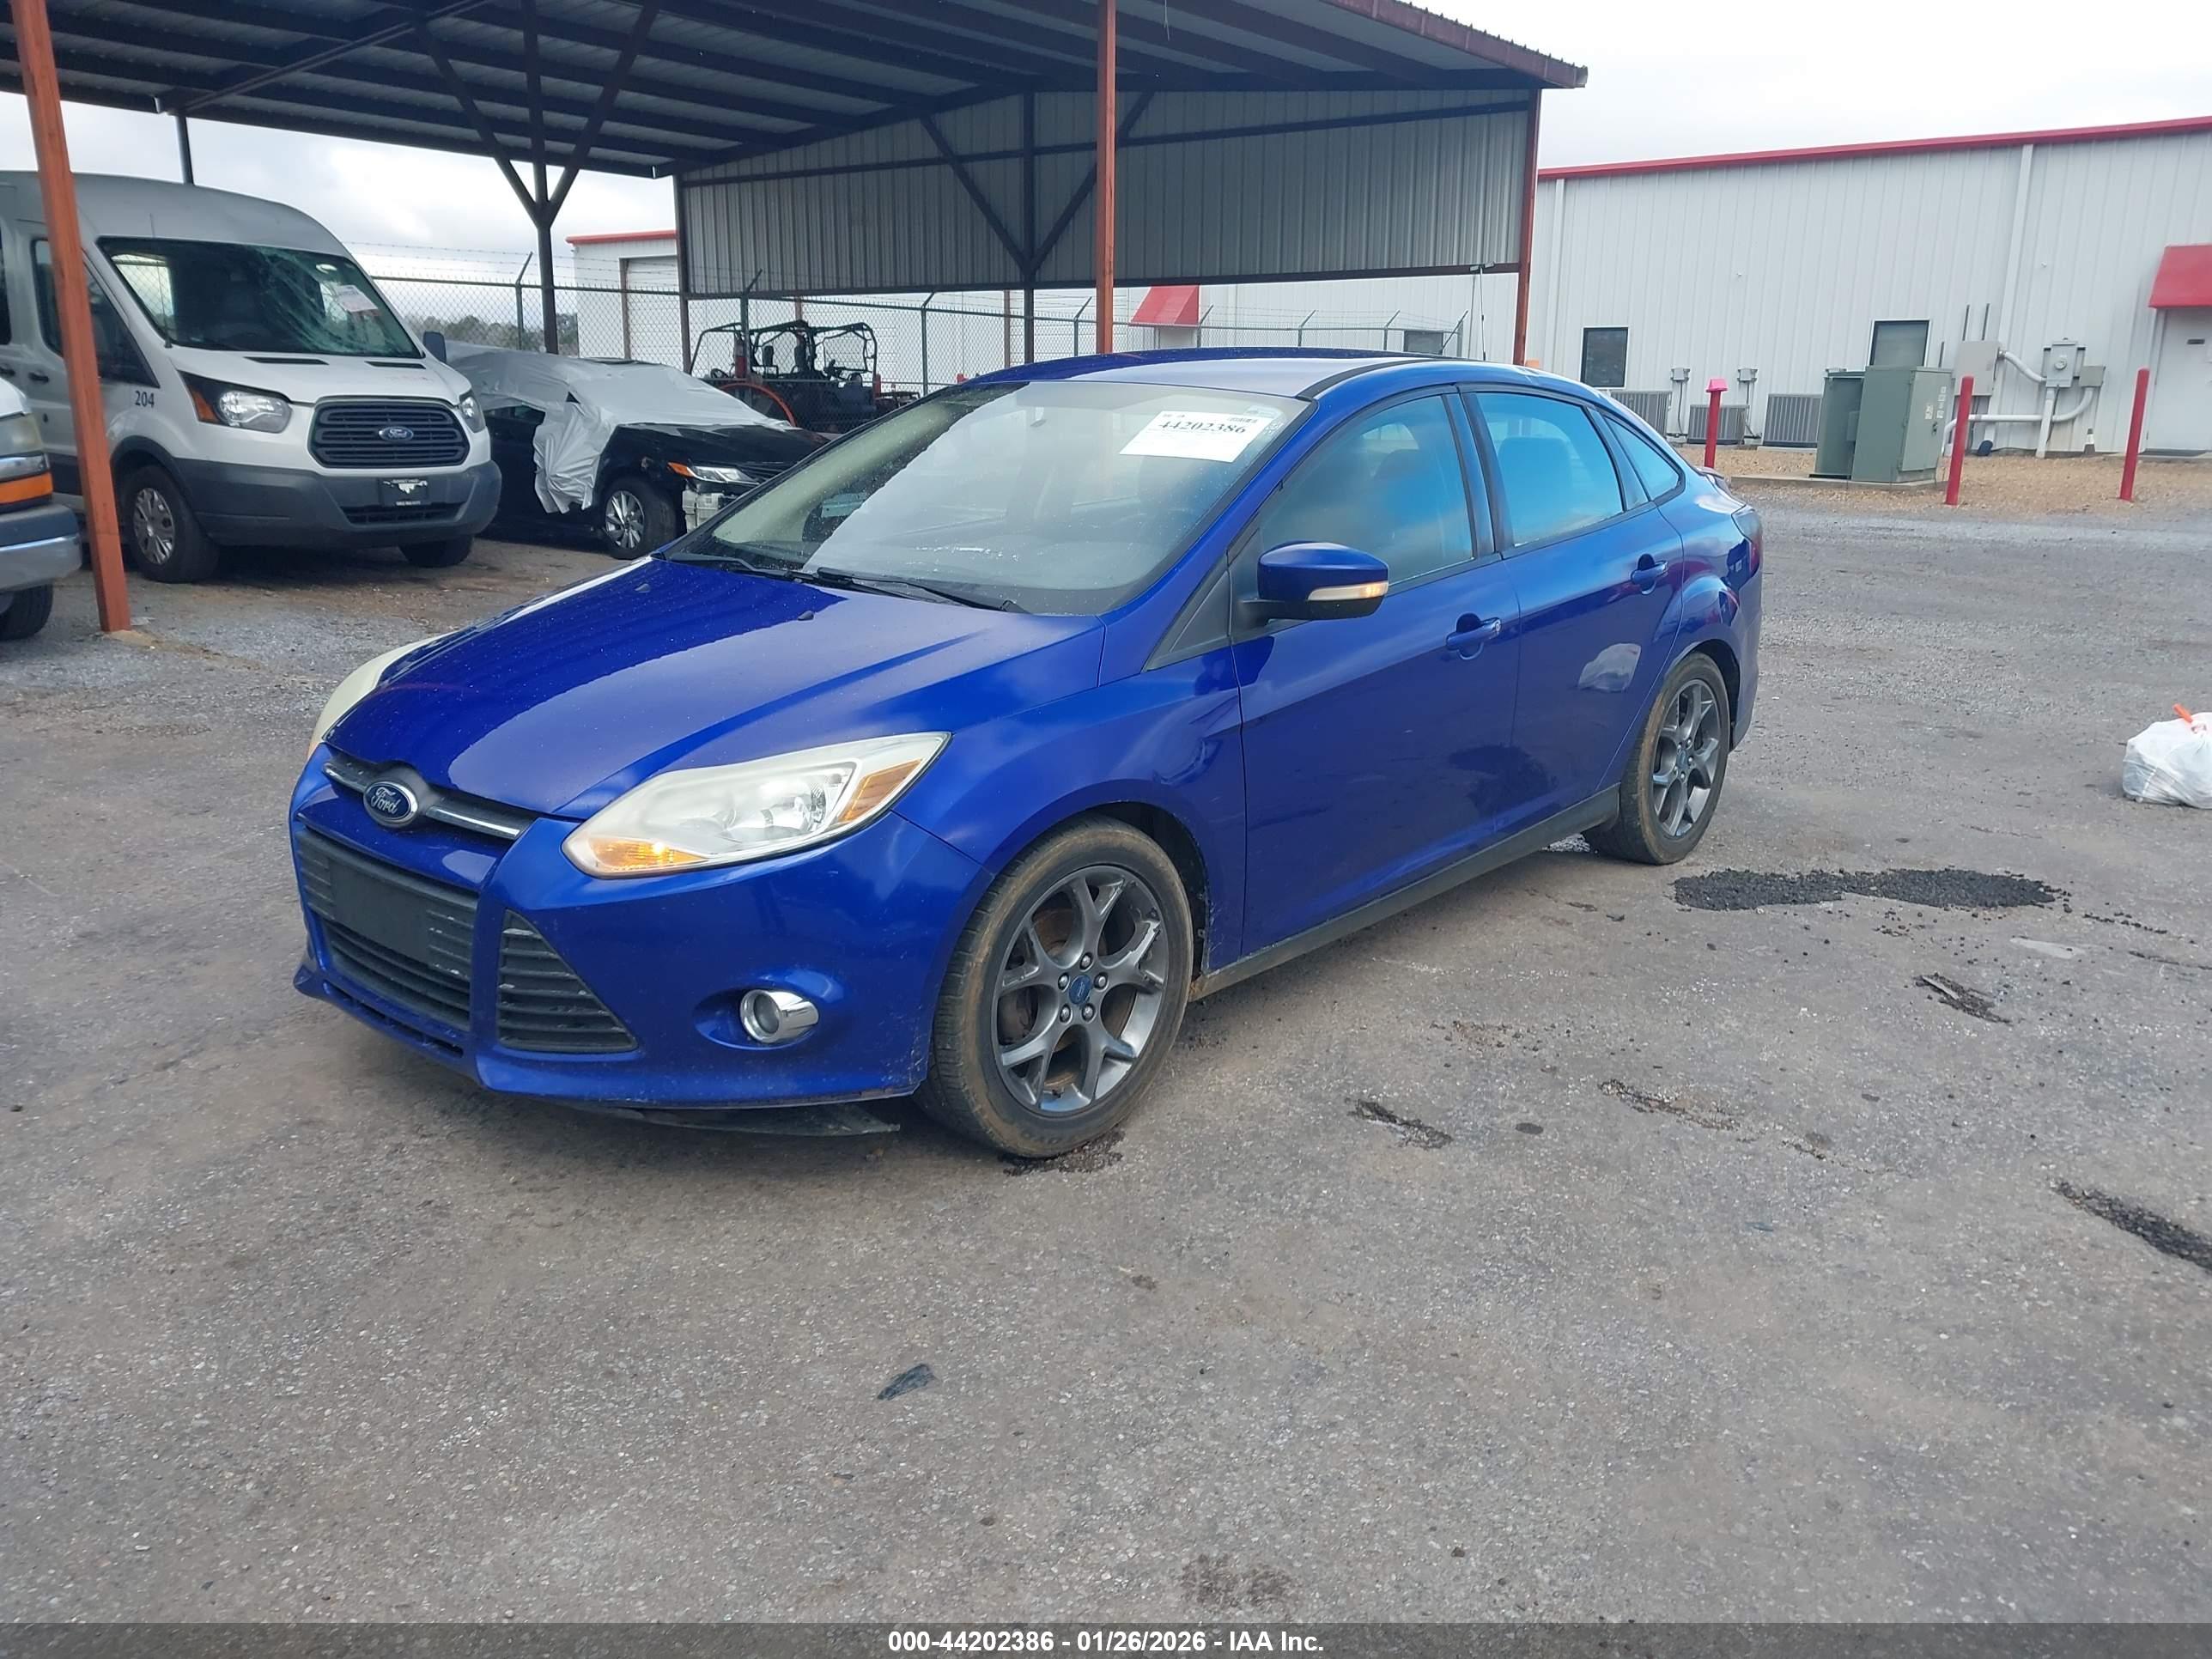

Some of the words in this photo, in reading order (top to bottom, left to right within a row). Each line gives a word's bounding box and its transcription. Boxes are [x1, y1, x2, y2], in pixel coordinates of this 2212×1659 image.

[134, 390, 155, 409] 204
[1158, 421, 1247, 434] 44202386
[370, 786, 402, 815] Ford
